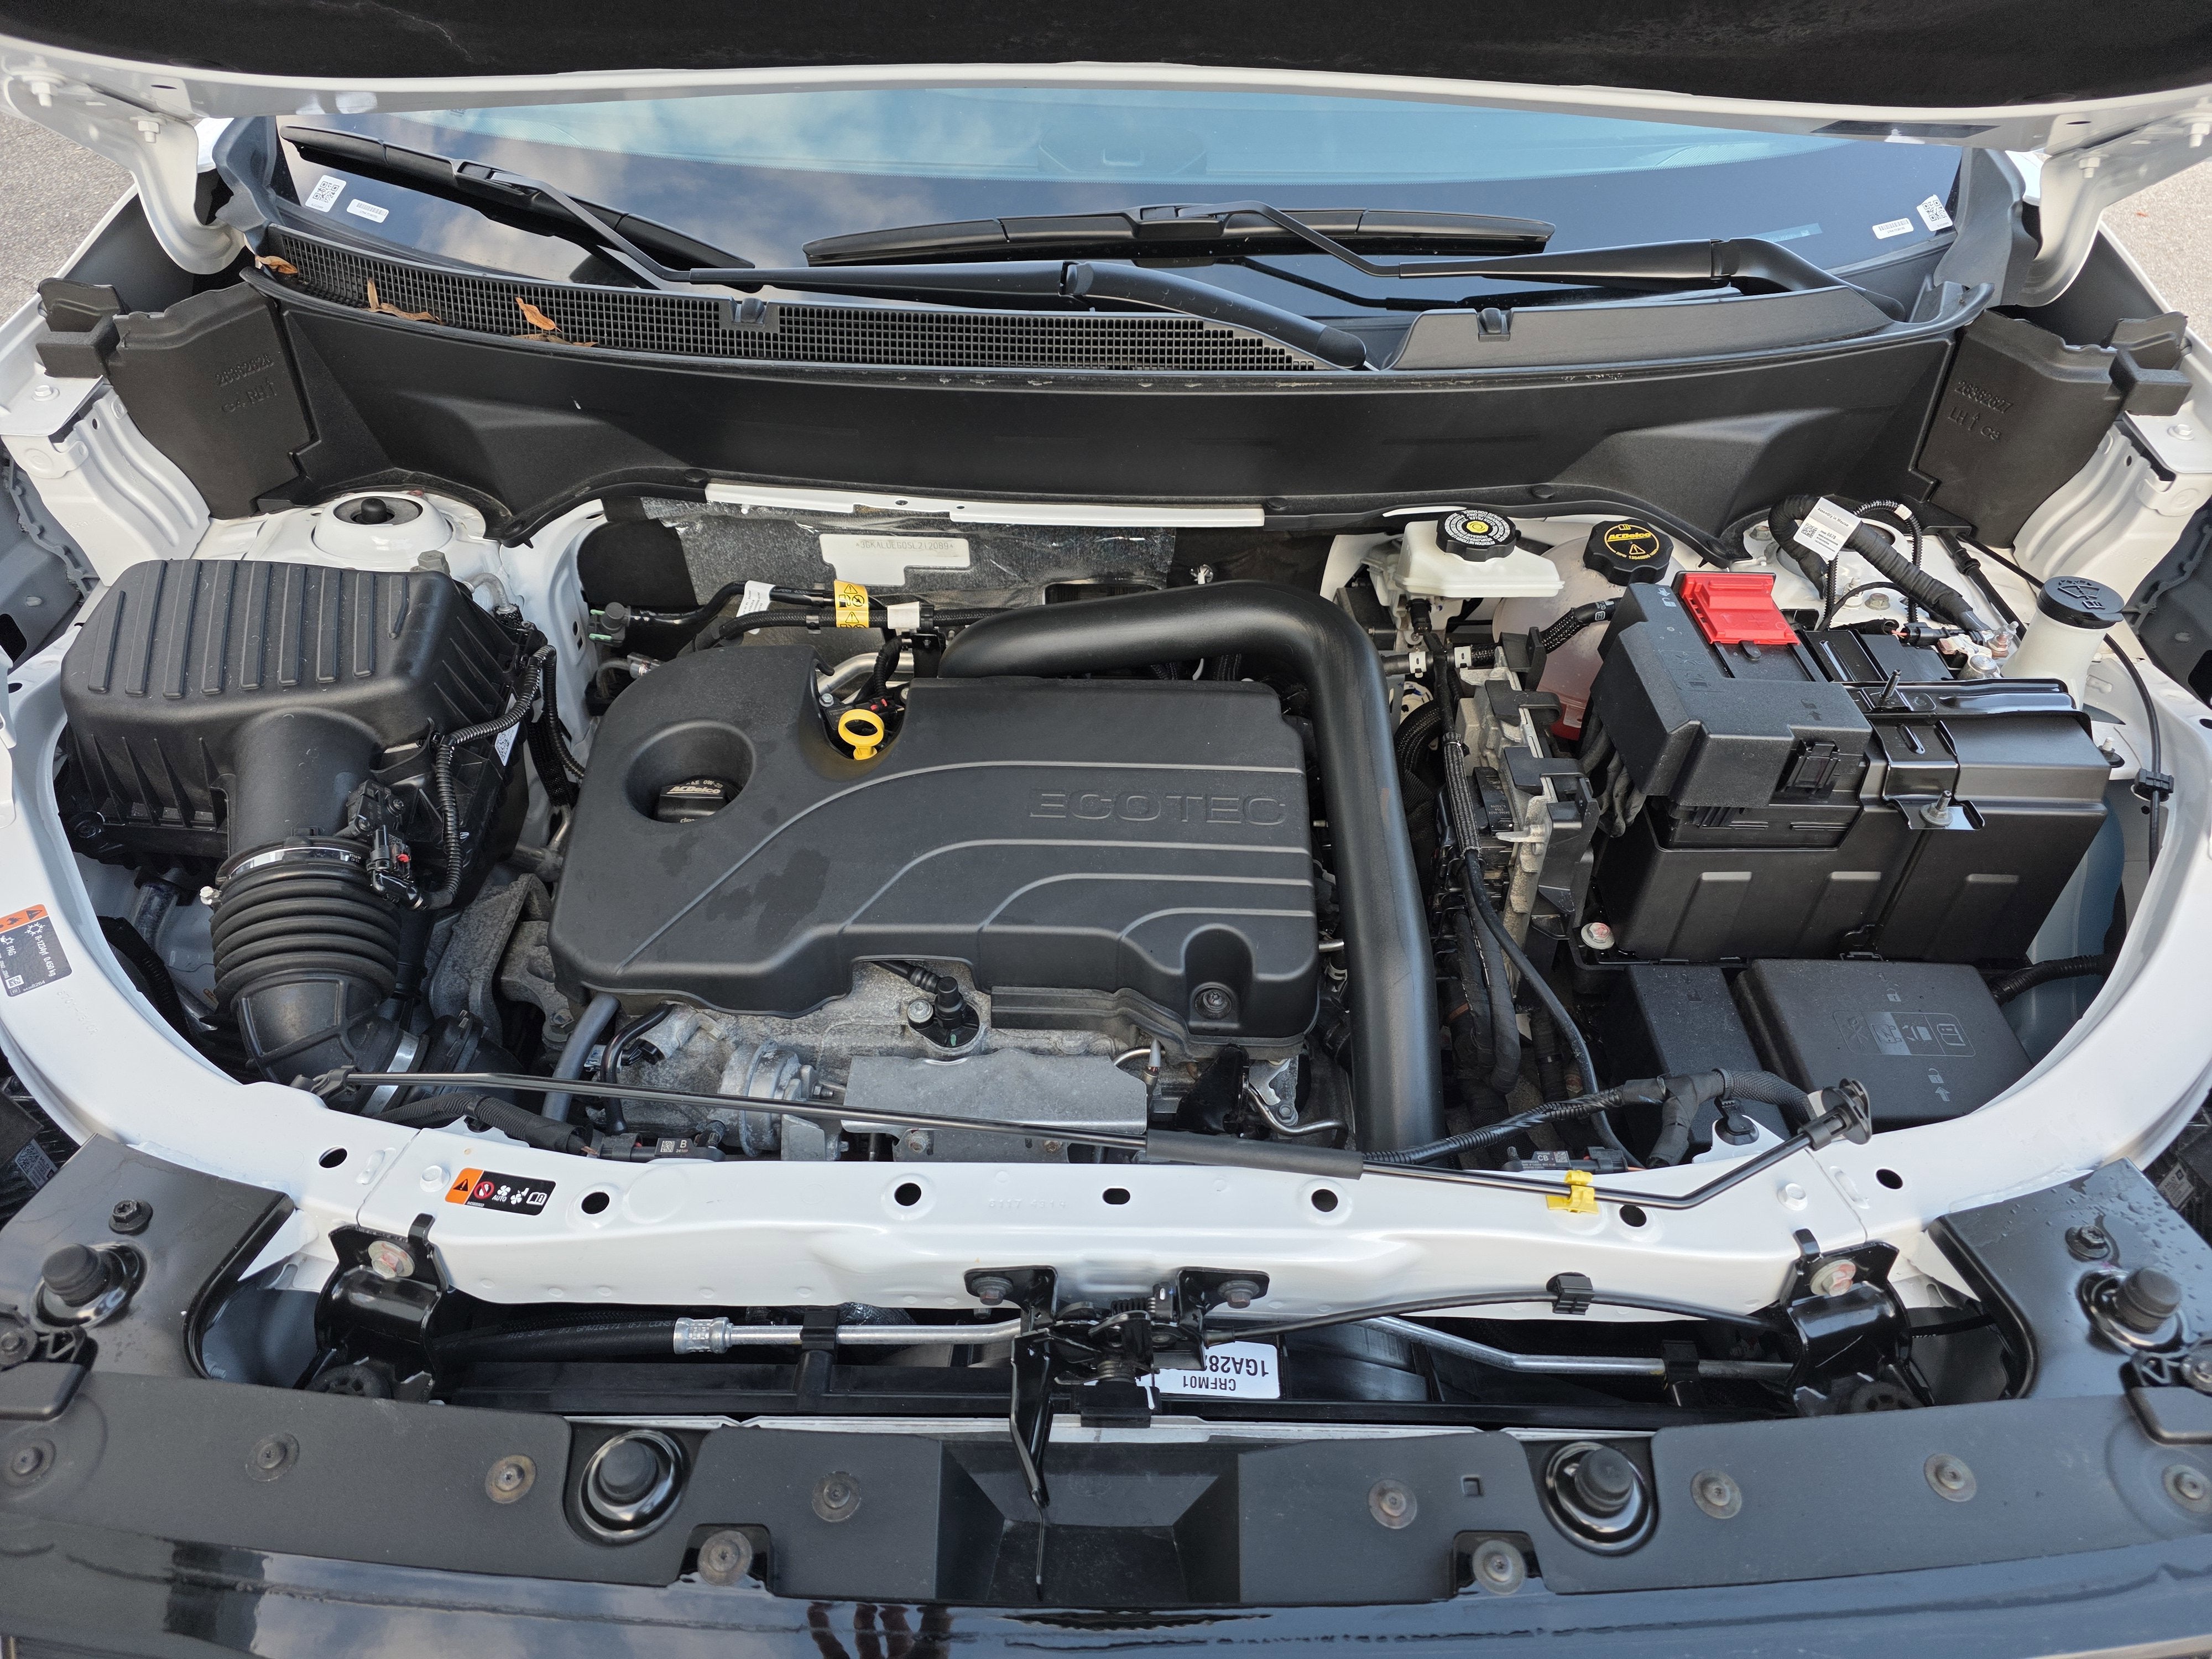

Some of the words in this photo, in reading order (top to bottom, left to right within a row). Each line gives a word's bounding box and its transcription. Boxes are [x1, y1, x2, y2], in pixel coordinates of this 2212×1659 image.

[1030, 789, 1287, 826] ECOTEC
[6, 945, 17, 956] PAG
[48, 969, 56, 977] kg
[680, 1140, 687, 1148] B
[1204, 1355, 1269, 1377] 1GA28
[1183, 1375, 1237, 1391] CRFM01
